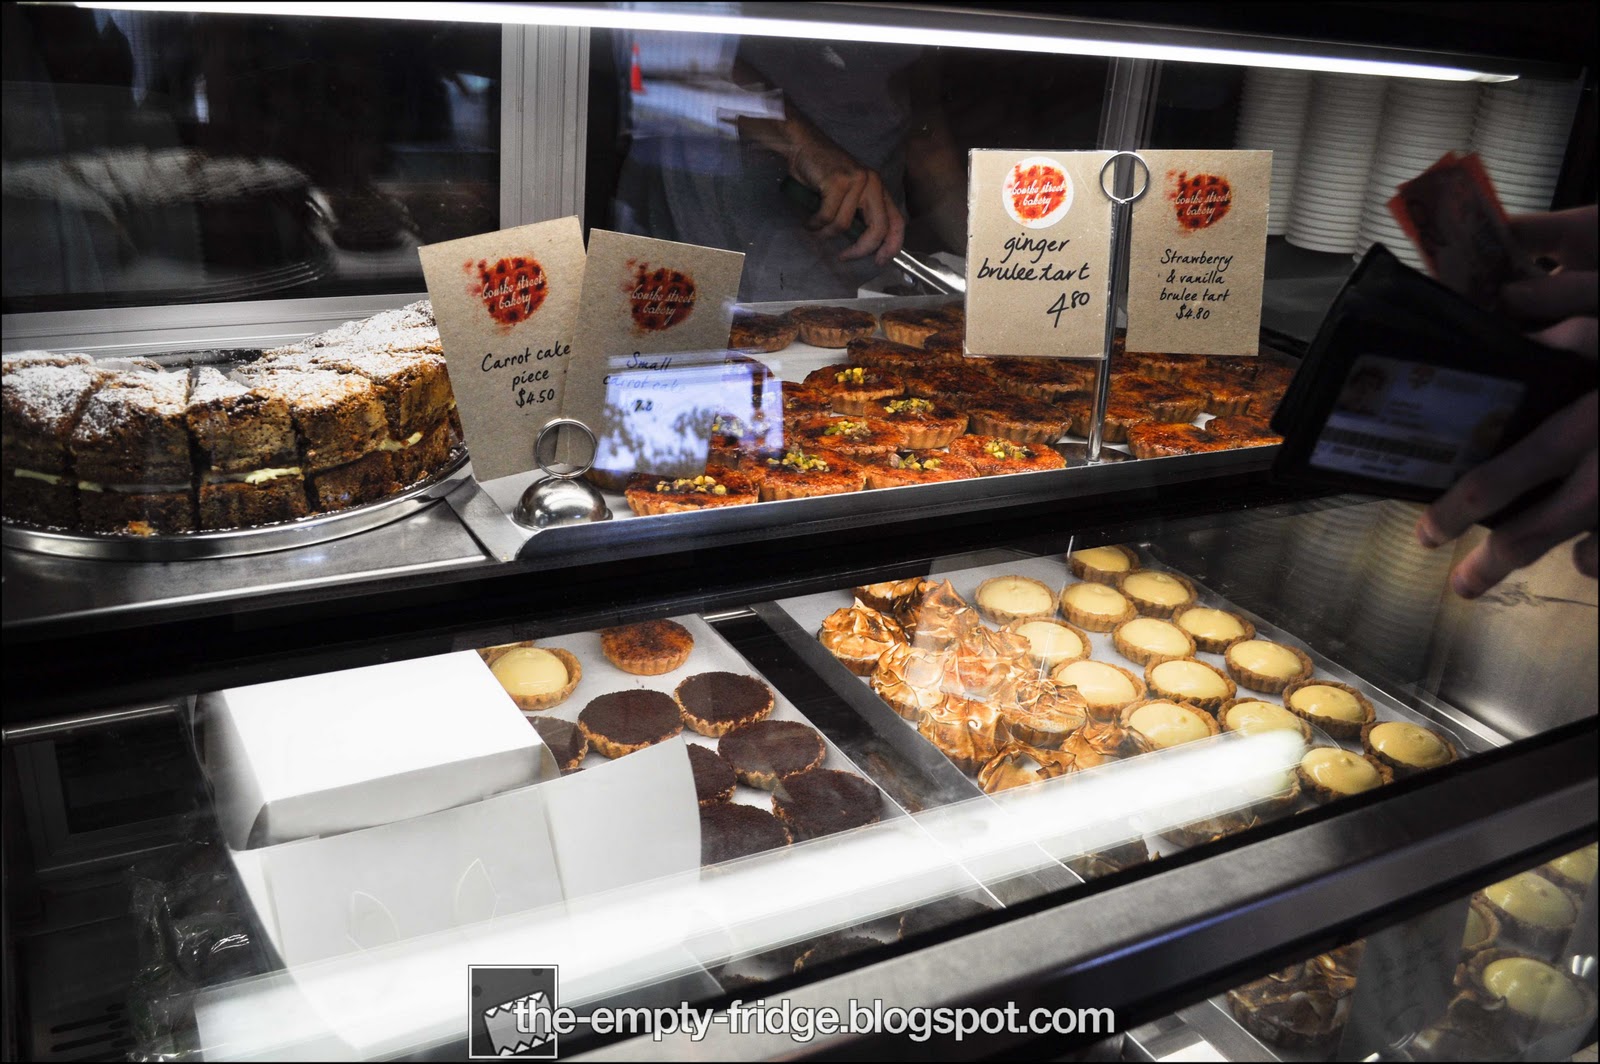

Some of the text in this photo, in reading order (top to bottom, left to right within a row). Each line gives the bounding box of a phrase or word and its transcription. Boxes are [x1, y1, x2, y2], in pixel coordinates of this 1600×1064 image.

[1041, 180, 1066, 193] street
[1205, 190, 1230, 203] street
[1023, 195, 1052, 214] bakery
[1186, 205, 1216, 224] bakery
[1000, 232, 1070, 264] ginger
[977, 258, 1090, 282] brulee tart
[1160, 248, 1234, 273] Strawberry
[482, 270, 544, 300] bourke street
[1166, 269, 1225, 284] & vanilla
[498, 293, 532, 314] bakery
[667, 289, 695, 304] street
[1159, 287, 1230, 301] brulee tart
[642, 302, 677, 325] bakery
[1176, 303, 1211, 320] $4.80
[481, 341, 571, 373] Carrot cake
[626, 351, 672, 371] Small
[512, 370, 549, 391] piece
[516, 388, 555, 408] $4.50
